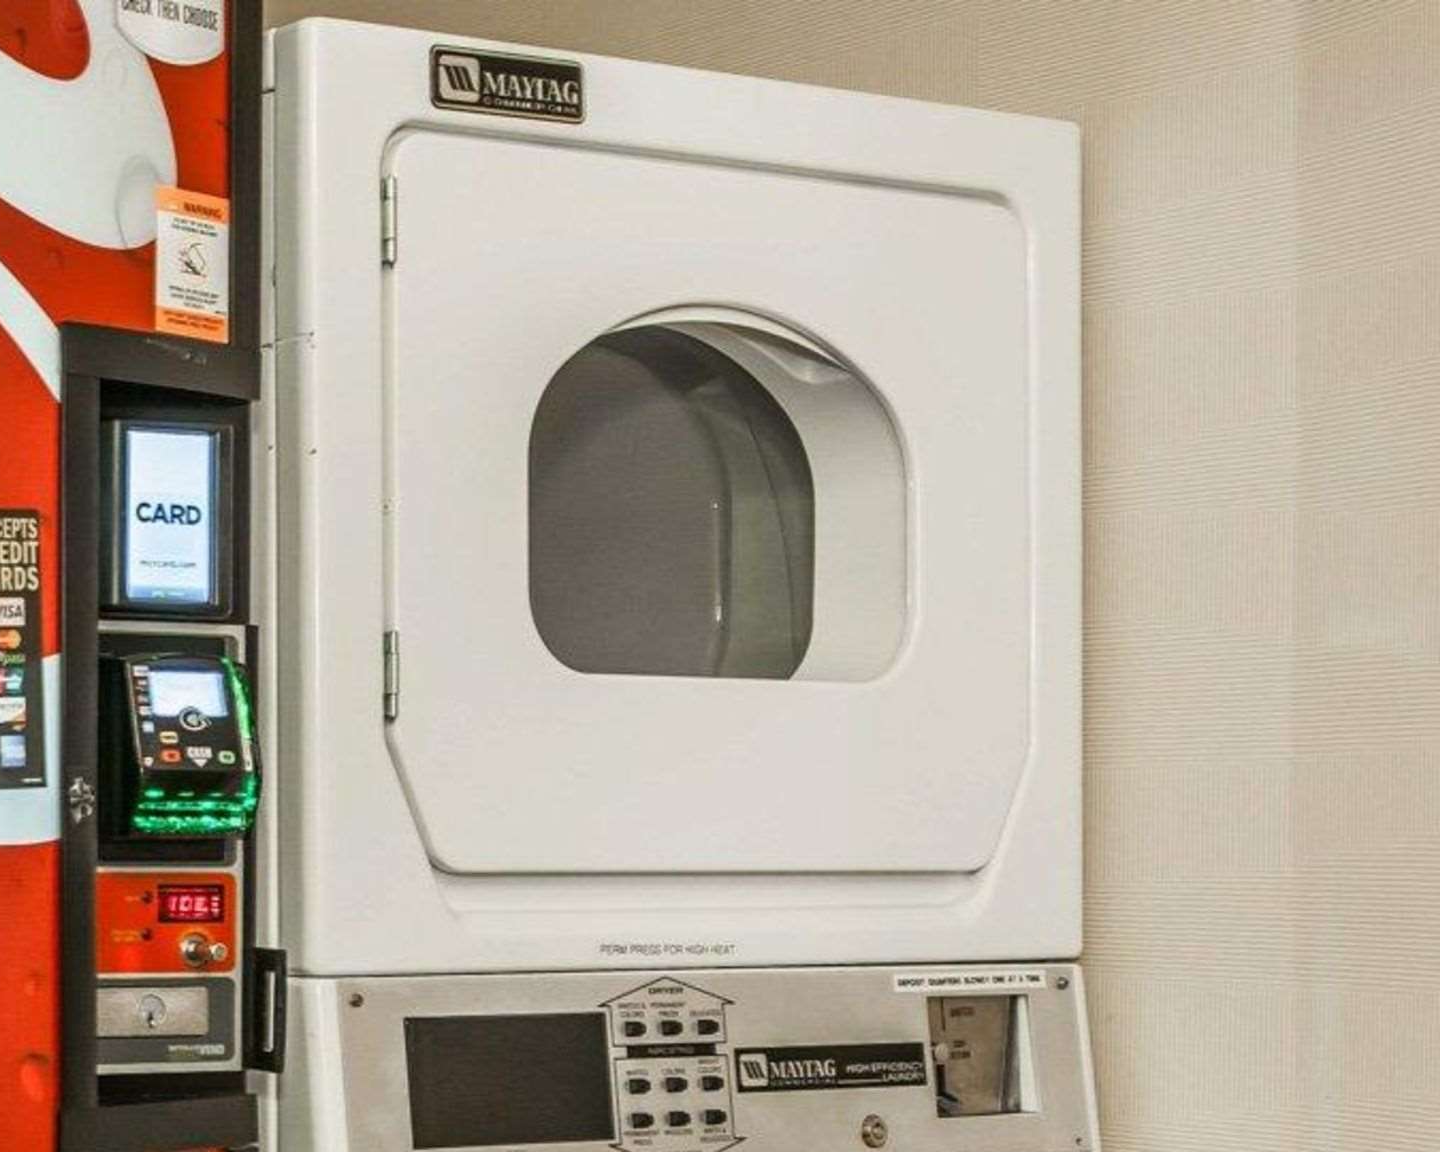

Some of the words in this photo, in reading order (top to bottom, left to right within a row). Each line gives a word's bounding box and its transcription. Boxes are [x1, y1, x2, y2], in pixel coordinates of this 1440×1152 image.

[483, 72, 578, 105] MAYTAG
[136, 502, 202, 525] CARD
[769, 1059, 836, 1079] MAYTAG
